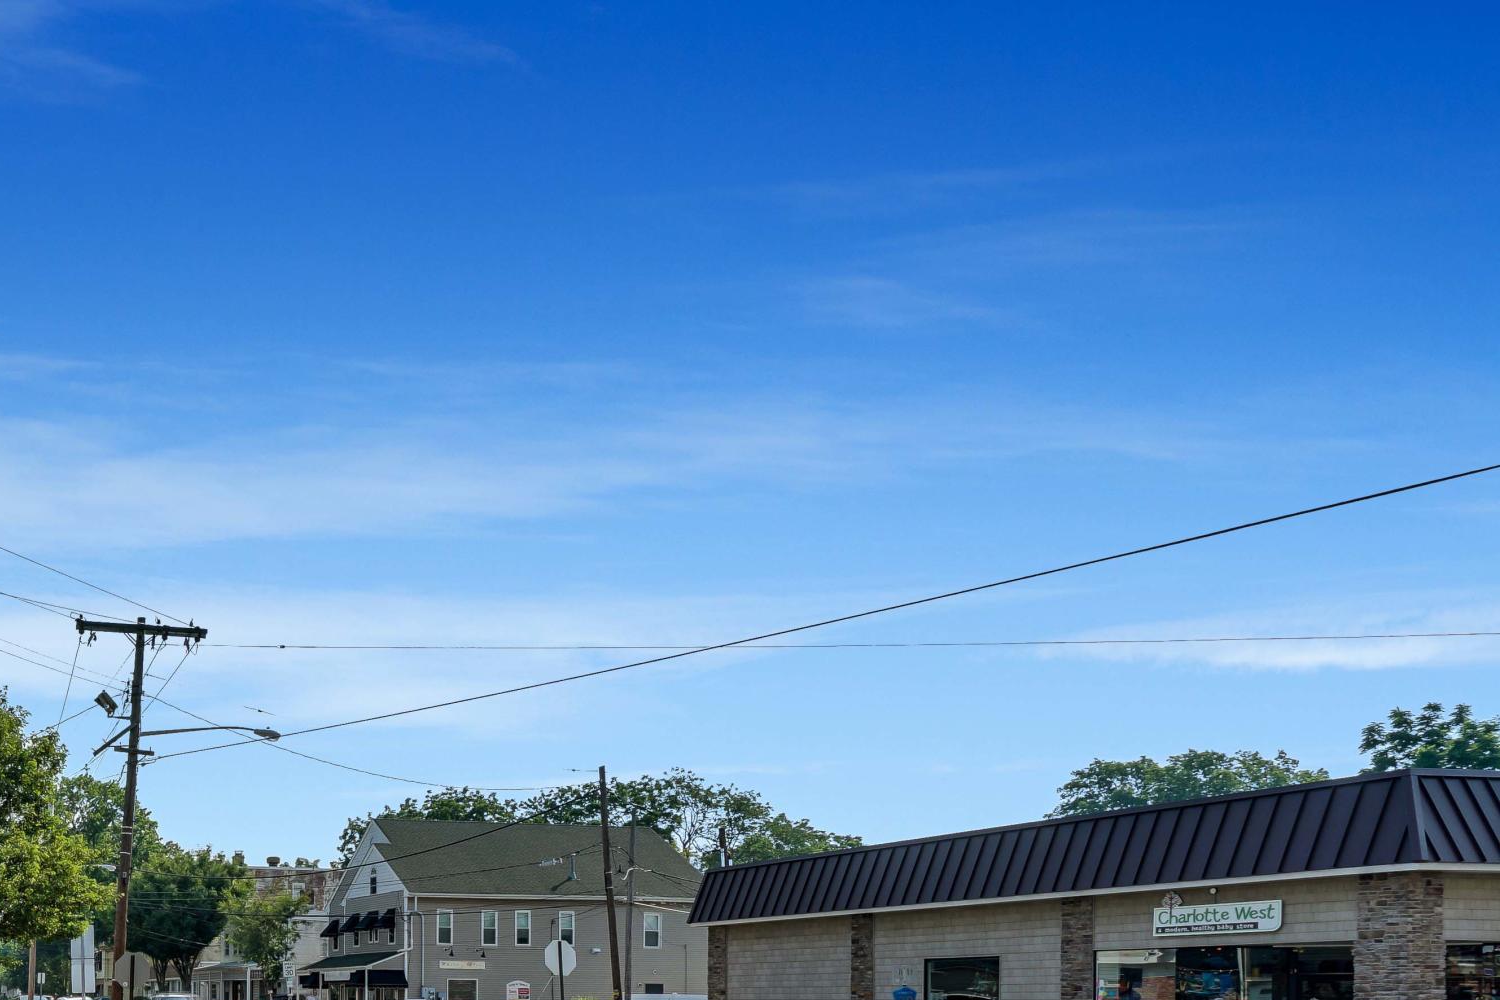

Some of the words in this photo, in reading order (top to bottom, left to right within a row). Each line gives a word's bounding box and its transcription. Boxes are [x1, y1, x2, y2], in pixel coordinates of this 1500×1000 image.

[1158, 907, 1230, 925] Charlotte
[1234, 903, 1276, 921] West
[1191, 923, 1216, 932] healthy
[1216, 921, 1234, 931] baby
[1235, 921, 1255, 930] store
